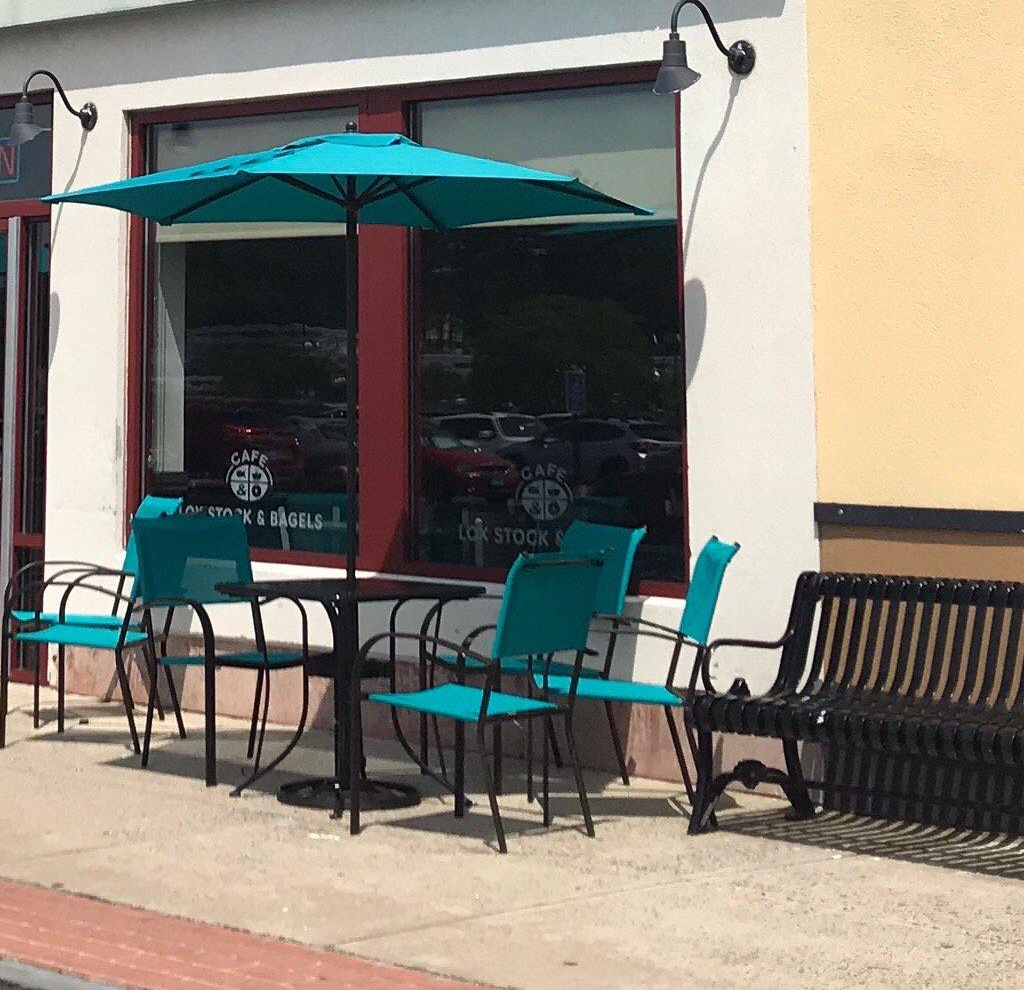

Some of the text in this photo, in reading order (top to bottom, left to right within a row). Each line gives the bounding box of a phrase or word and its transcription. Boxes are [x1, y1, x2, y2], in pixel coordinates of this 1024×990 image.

[231, 448, 269, 468] CAFE
[521, 463, 567, 482] CAFE
[256, 509, 265, 526] &
[270, 509, 323, 530] BAGELS
[458, 523, 489, 543] LOX
[493, 526, 549, 548] STOCK
